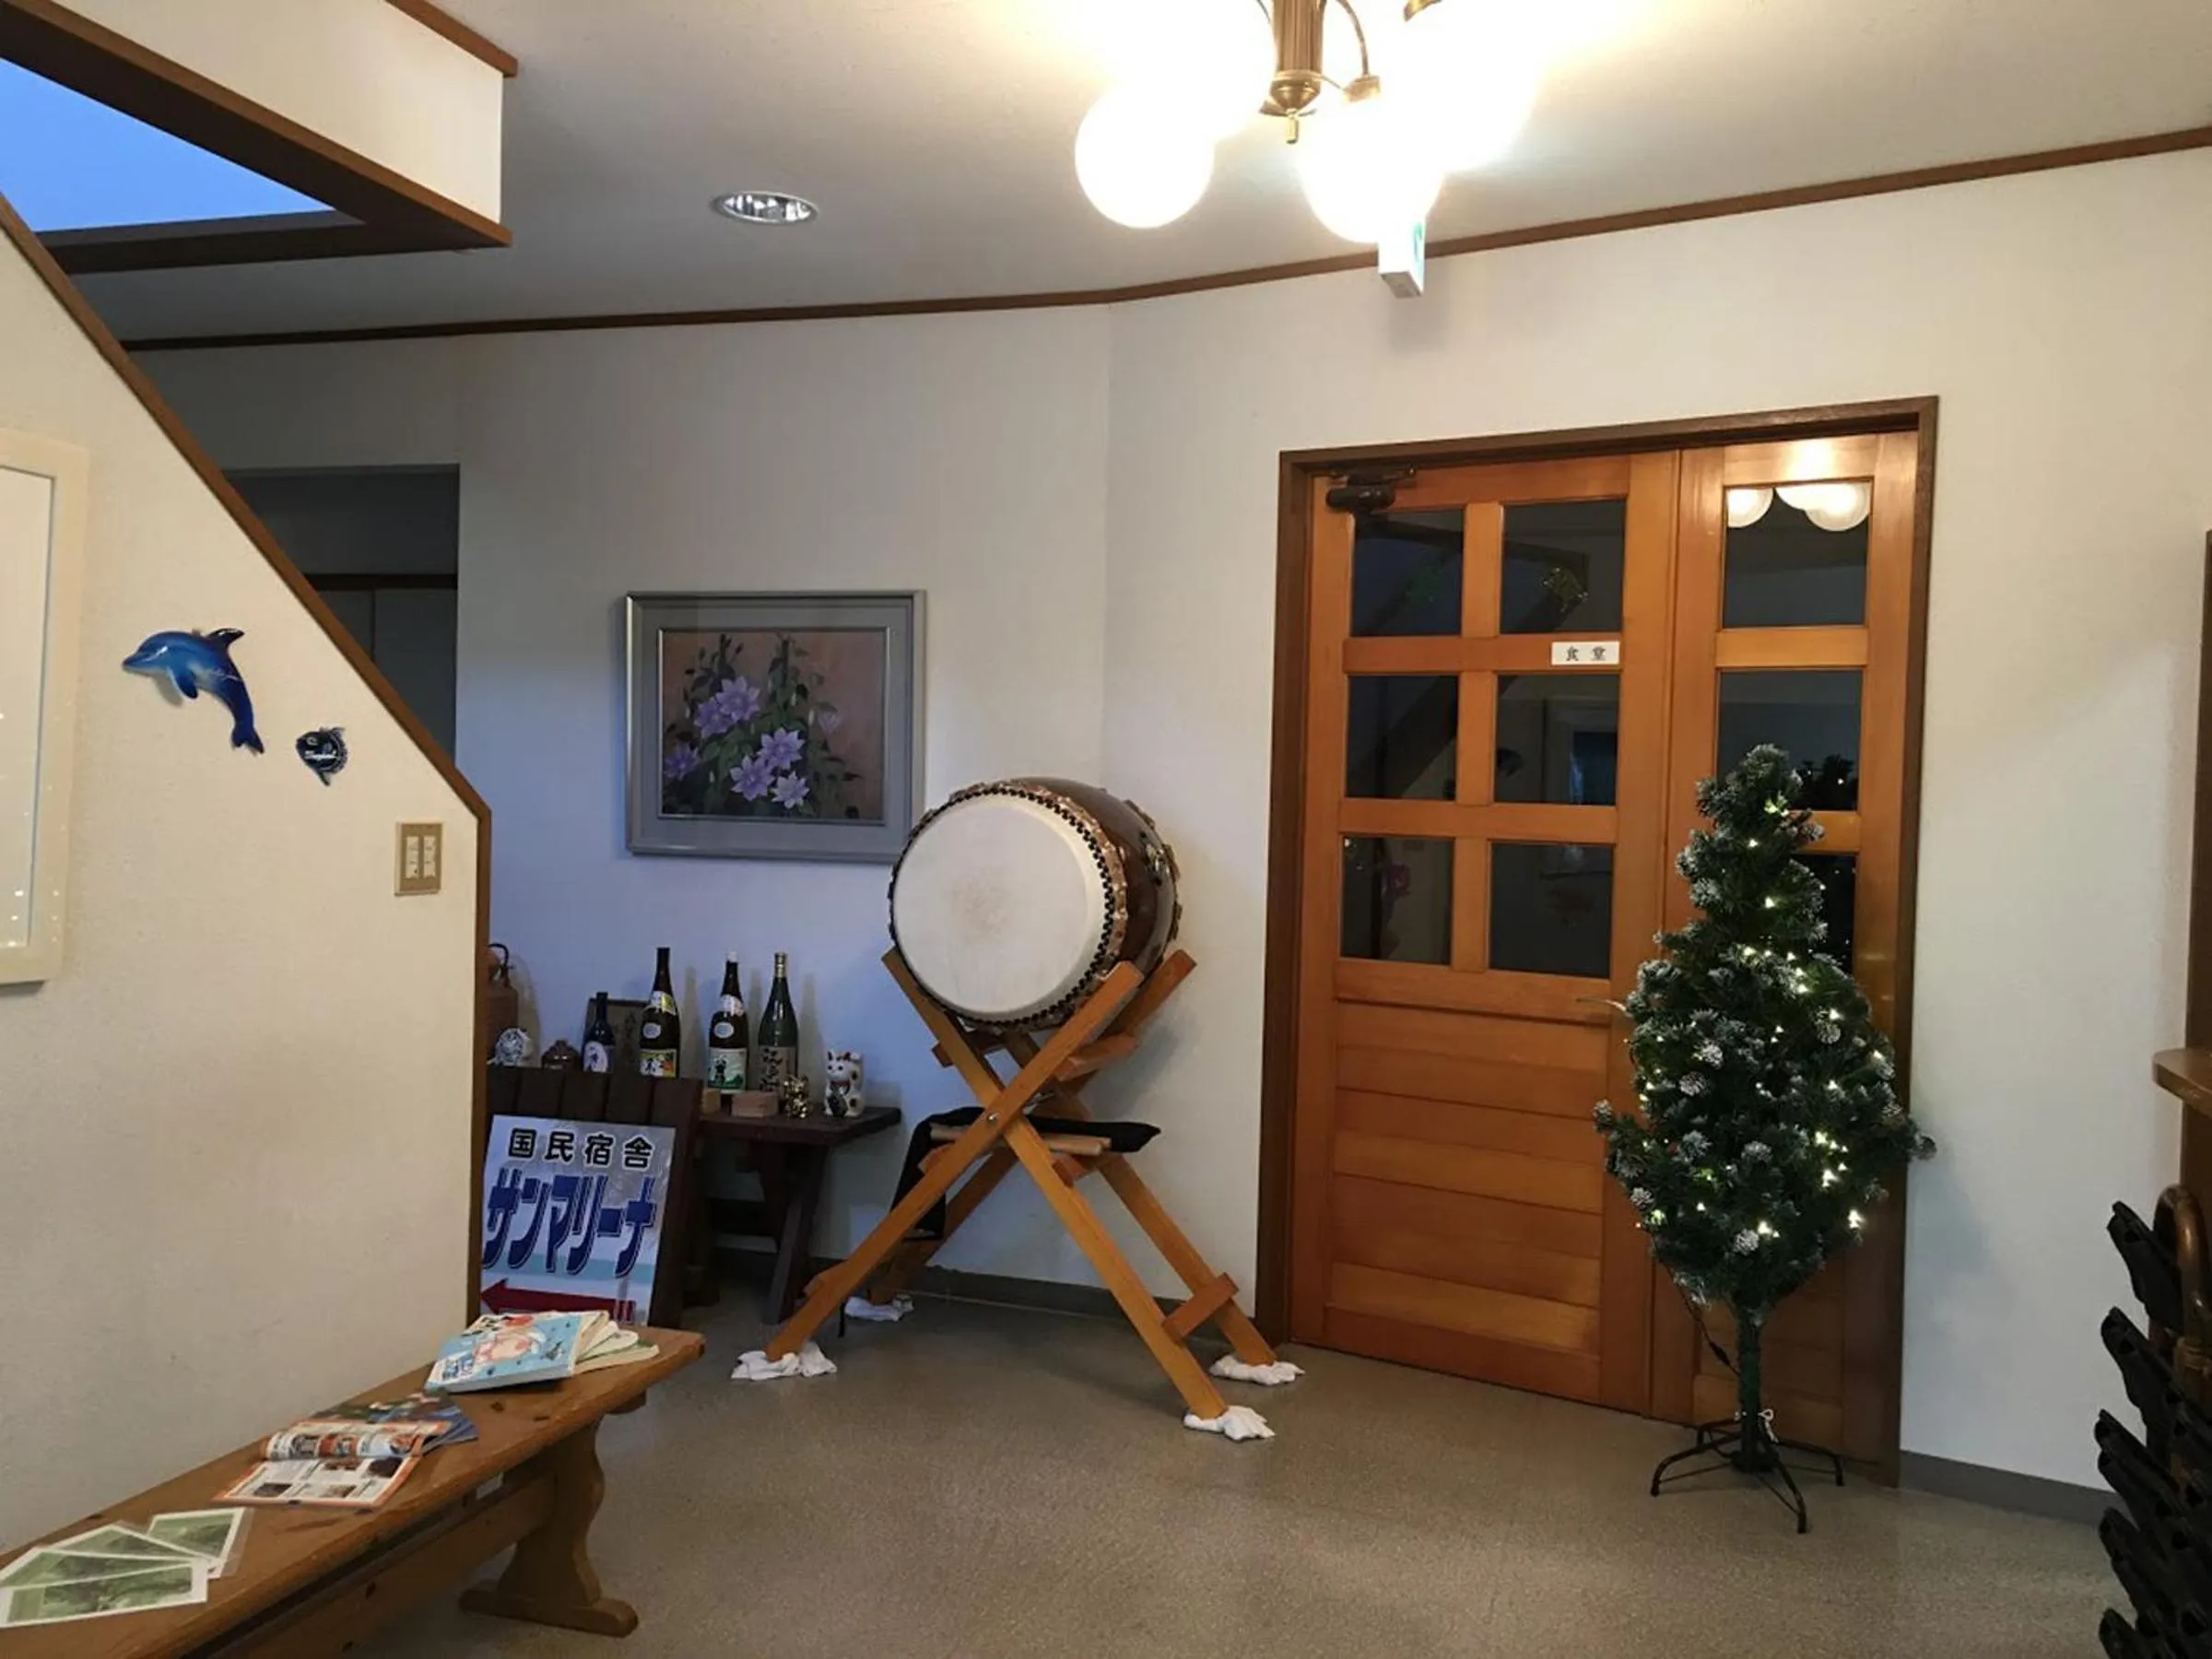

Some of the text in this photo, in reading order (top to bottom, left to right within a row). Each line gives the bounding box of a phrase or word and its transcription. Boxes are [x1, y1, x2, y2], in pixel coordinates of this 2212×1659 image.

[508, 1127, 653, 1169] 国民宿舎
[482, 1168, 656, 1278] サンマリーナ
